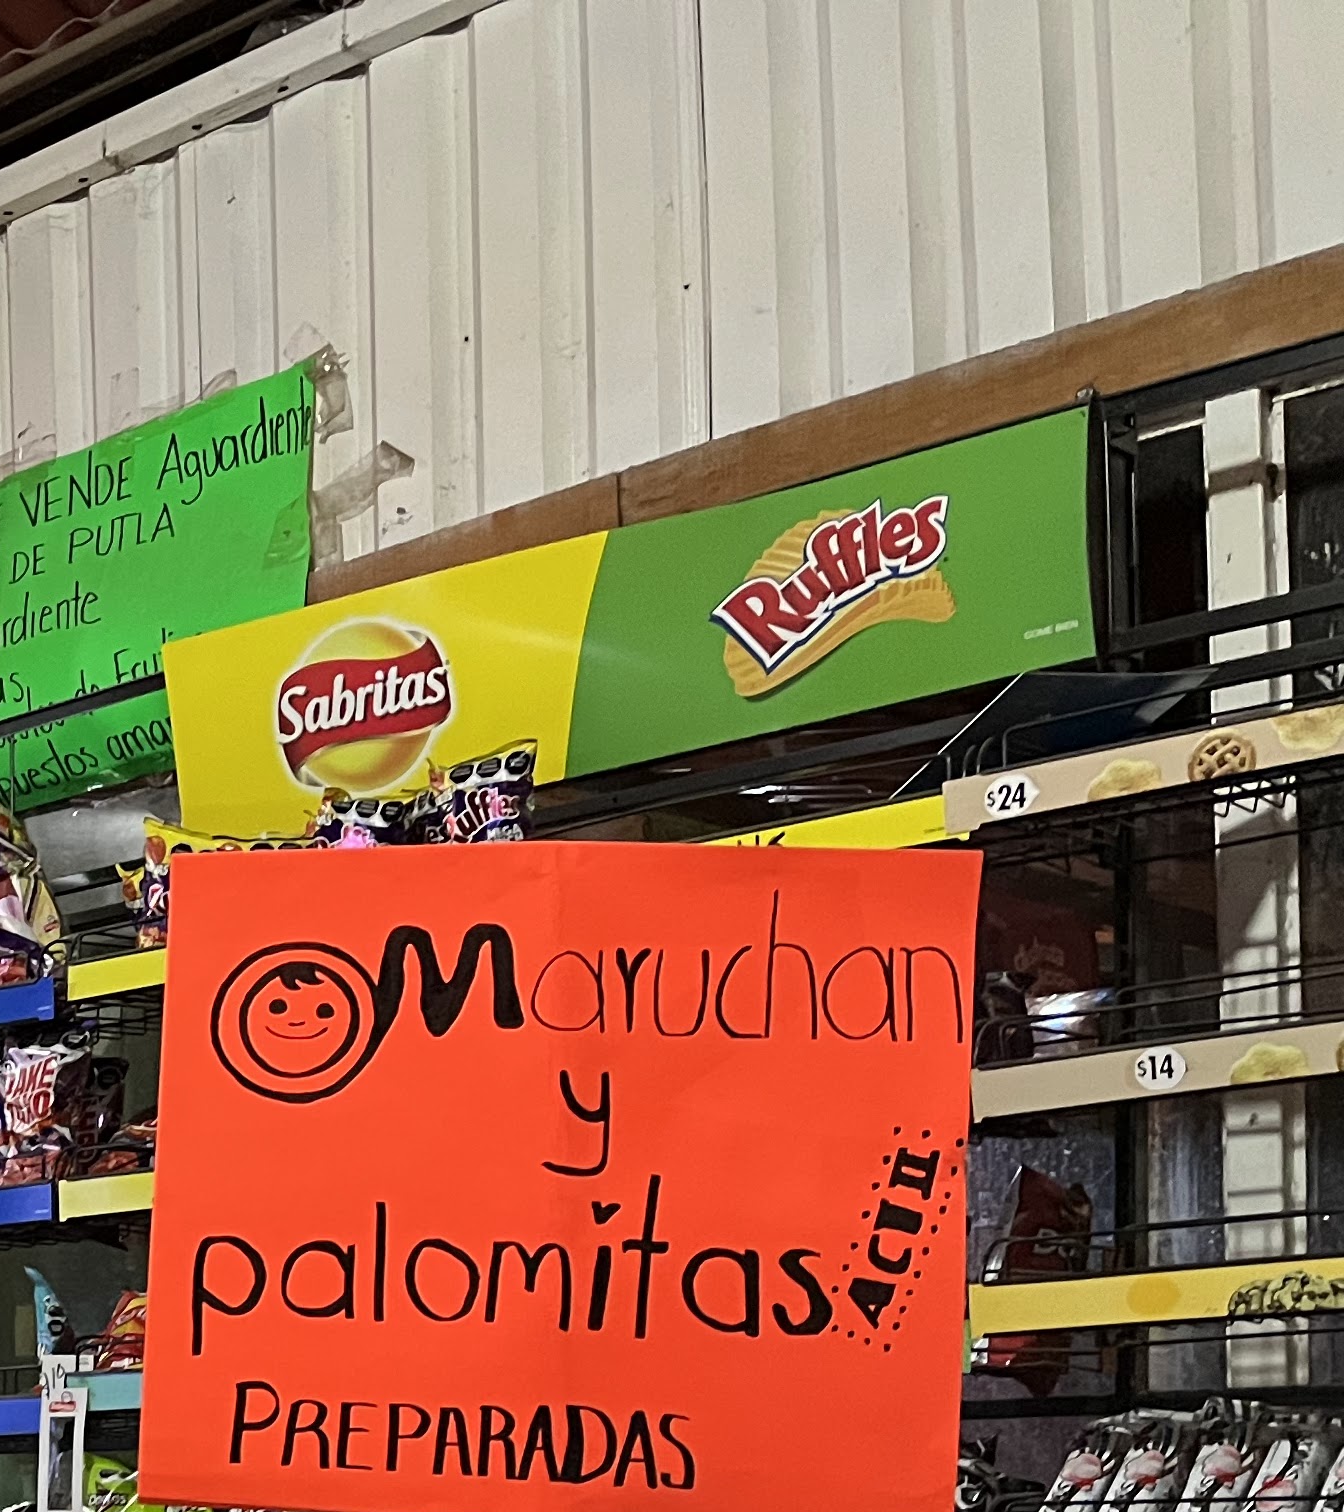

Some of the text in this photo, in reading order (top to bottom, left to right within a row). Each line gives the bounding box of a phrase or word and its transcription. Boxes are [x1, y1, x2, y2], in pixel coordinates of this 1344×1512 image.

[18, 450, 133, 528] VENDE
[157, 375, 312, 506] Aguardiente
[9, 504, 175, 585] DE PUTLA
[714, 496, 949, 672] Ruffles
[278, 664, 447, 742] Sabritas
[987, 783, 1027, 810] $24
[375, 889, 965, 1044] Maruchan
[1137, 1054, 1174, 1080] $14
[542, 1067, 610, 1178] y
[190, 1173, 836, 1356] palomitas
[230, 1381, 696, 1490] PREPARADAS
